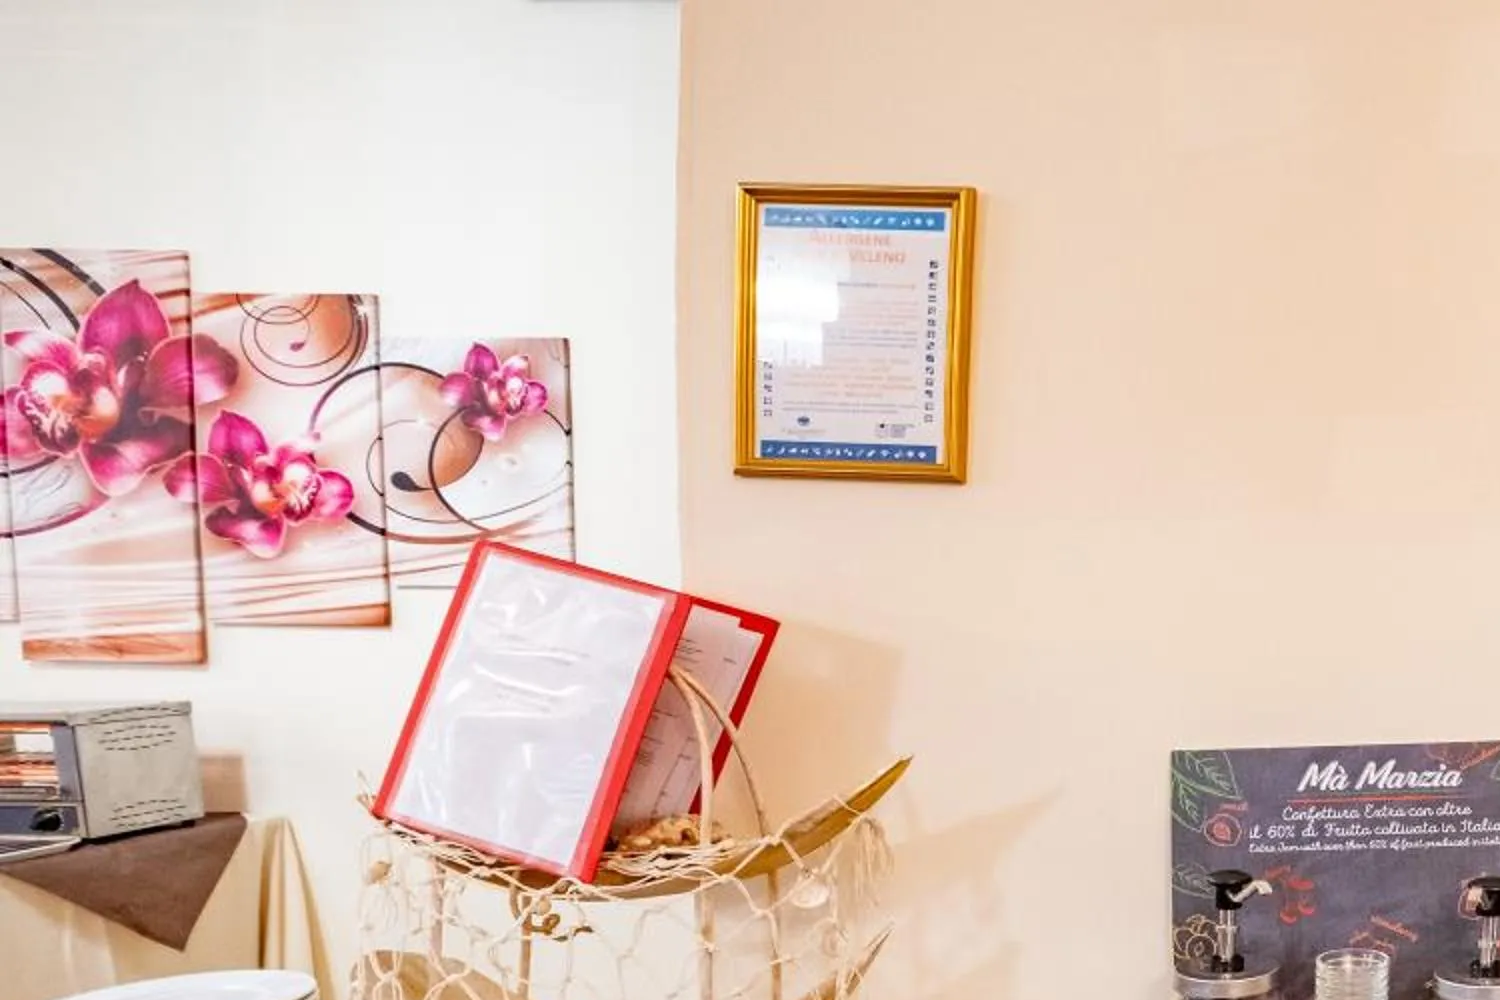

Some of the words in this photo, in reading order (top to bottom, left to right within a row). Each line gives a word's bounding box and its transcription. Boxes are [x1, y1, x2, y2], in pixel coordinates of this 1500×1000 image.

[1296, 760, 1349, 792] Mà
[1355, 758, 1463, 790] Marzia
[1281, 805, 1360, 825] Confettura
[1363, 803, 1406, 820] Extra
[1408, 806, 1434, 818] con
[1435, 801, 1473, 817] oltre
[1249, 824, 1263, 839] il
[1267, 825, 1296, 839] 60%
[1301, 823, 1319, 837] di
[1323, 823, 1373, 837] Frutta
[1374, 821, 1440, 835] coltivata
[1441, 822, 1457, 833] in
